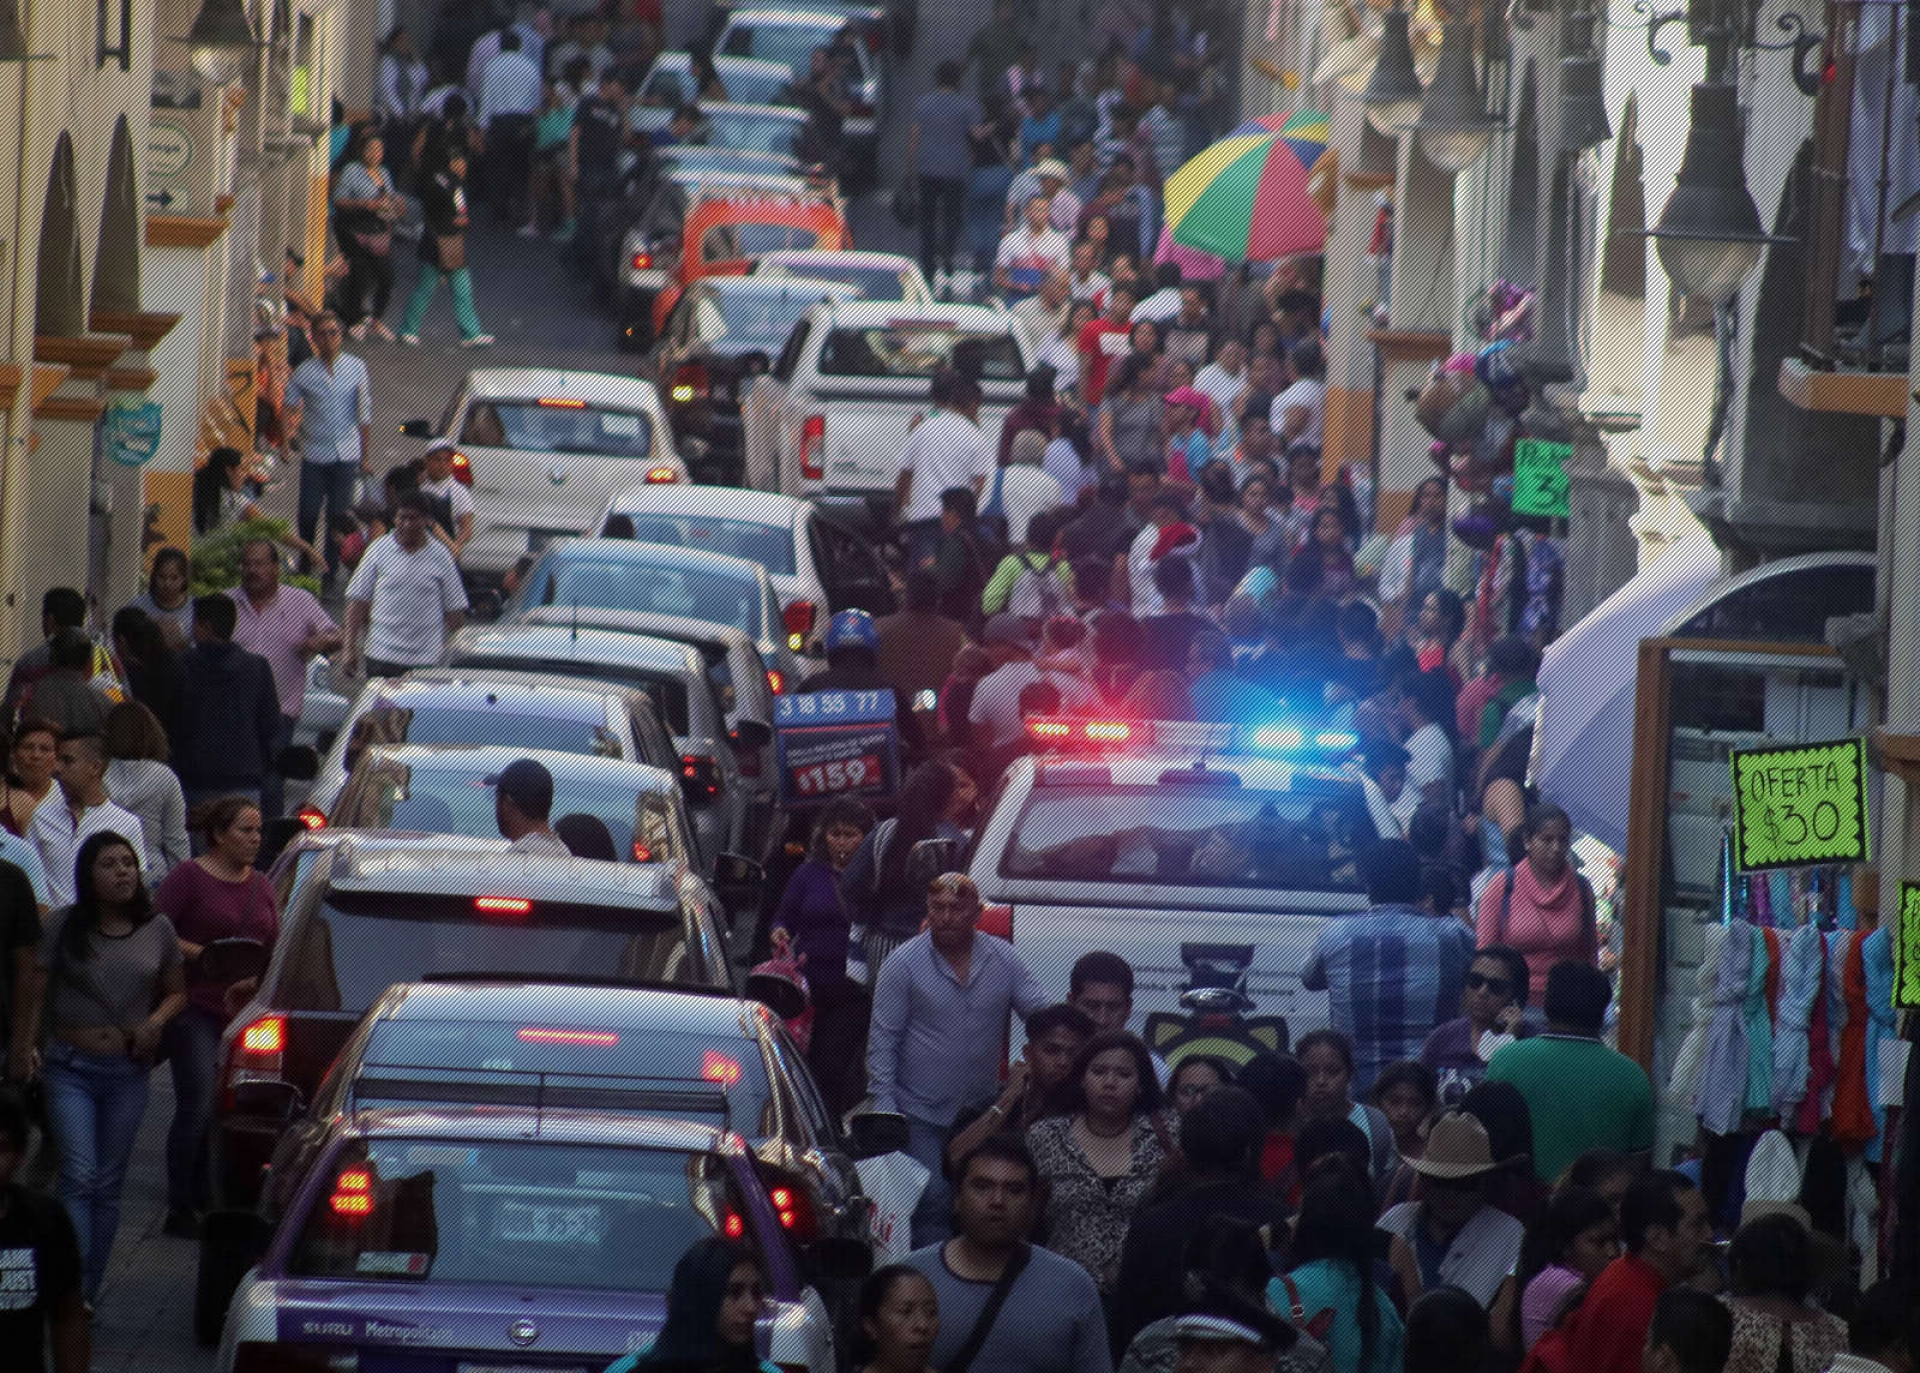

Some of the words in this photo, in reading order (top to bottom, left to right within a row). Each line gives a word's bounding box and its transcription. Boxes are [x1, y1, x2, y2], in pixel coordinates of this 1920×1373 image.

[780, 697, 792, 716] 3
[798, 695, 815, 714] 18
[821, 693, 846, 713] 55
[856, 691, 878, 712] 77
[797, 759, 867, 793] $159
[1751, 761, 1841, 803] OFERTA
[1763, 800, 1841, 850] $30
[0, 1270, 37, 1291] JUST
[365, 1320, 454, 1343] Metropolitano
